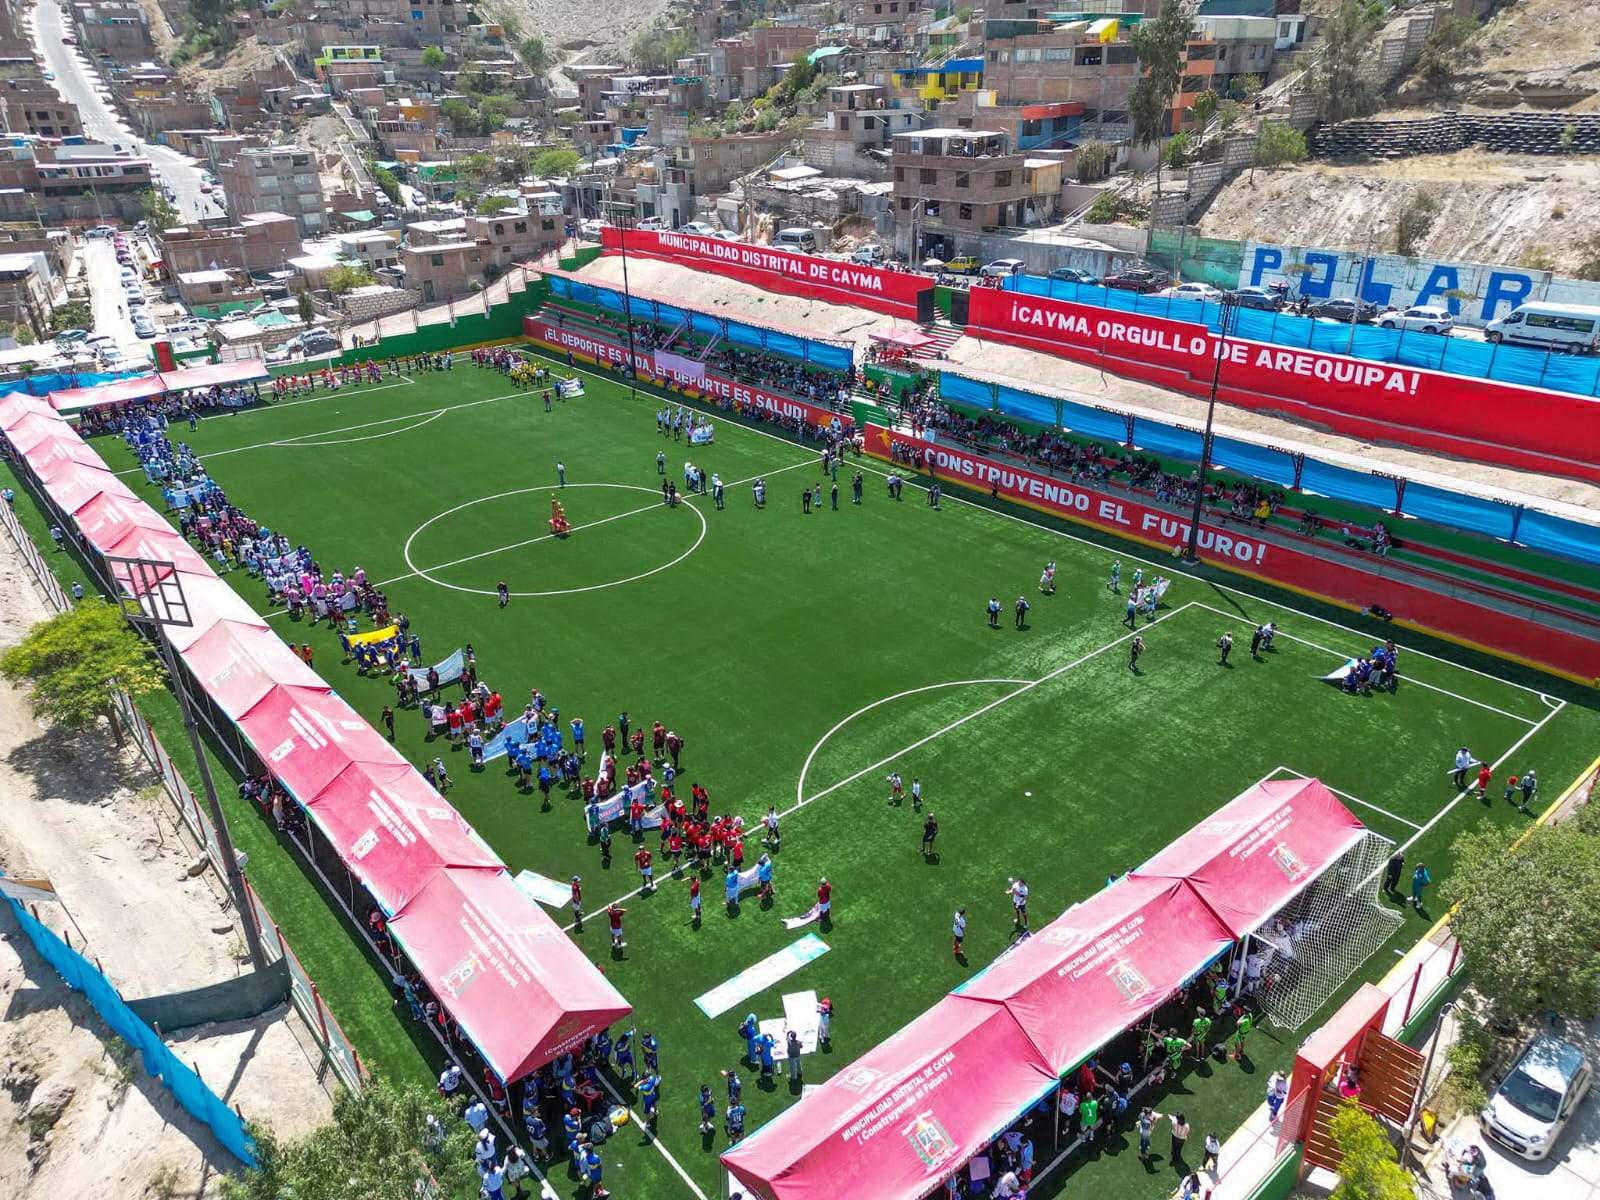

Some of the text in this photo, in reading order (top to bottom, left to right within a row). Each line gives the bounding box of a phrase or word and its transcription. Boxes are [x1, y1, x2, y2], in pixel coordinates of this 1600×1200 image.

[658, 233, 882, 290] MUNICIPALIDAD DISTRITAL DE CAYMA
[1250, 247, 1535, 320] POLAR
[562, 333, 606, 357] DEPORTE
[608, 347, 621, 361] ES
[625, 353, 652, 373] VDA,
[733, 387, 751, 405] ES
[756, 394, 808, 421] SALUD!
[1011, 301, 1421, 395] ¡CAYMA, ORGULLO DE AREQUIPA!
[924, 448, 1267, 565] CONSTRUYENDO EL FUTURO!
[841, 1098, 894, 1142] MUNICIPALIDAD
[923, 1066, 935, 1079] DE
[862, 1097, 916, 1140] Construyendo
[922, 1071, 948, 1094] Futuro
